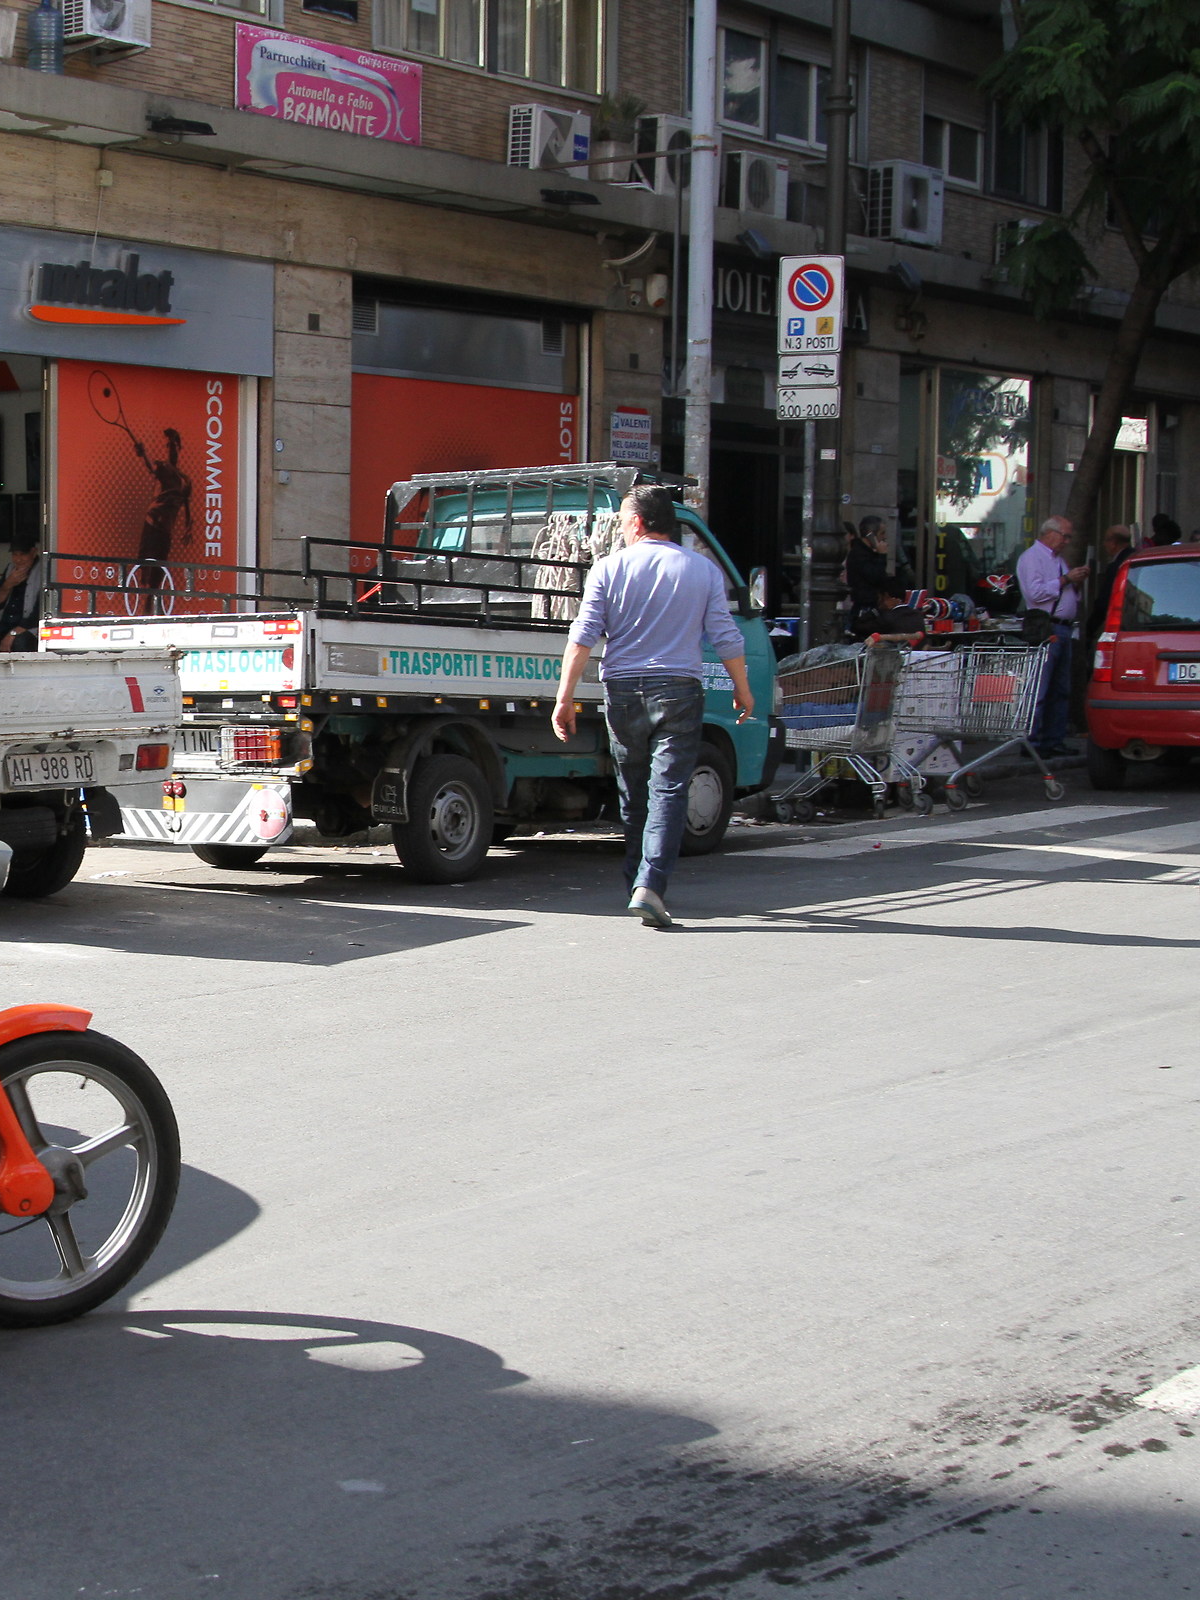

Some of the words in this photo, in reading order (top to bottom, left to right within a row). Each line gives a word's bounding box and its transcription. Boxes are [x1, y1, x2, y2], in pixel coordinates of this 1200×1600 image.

[259, 46, 326, 72] Parrucchieri
[287, 80, 335, 103] Antonella
[338, 95, 344, 105] e
[347, 92, 374, 111] Fabio
[283, 97, 378, 136] BRAMONTE
[38, 253, 175, 313] intralot
[785, 338, 802, 350] N.3
[806, 336, 834, 349] POSTI
[560, 402, 572, 462] SLOT
[620, 418, 650, 429] VALENTI
[205, 380, 223, 557] SCOMMESSE
[389, 651, 478, 678] TRASPORTI
[482, 656, 492, 678] E
[494, 656, 563, 681] TRASLOC
[12, 758, 32, 783] AH
[40, 757, 69, 780] 988
[74, 754, 94, 780] RD
